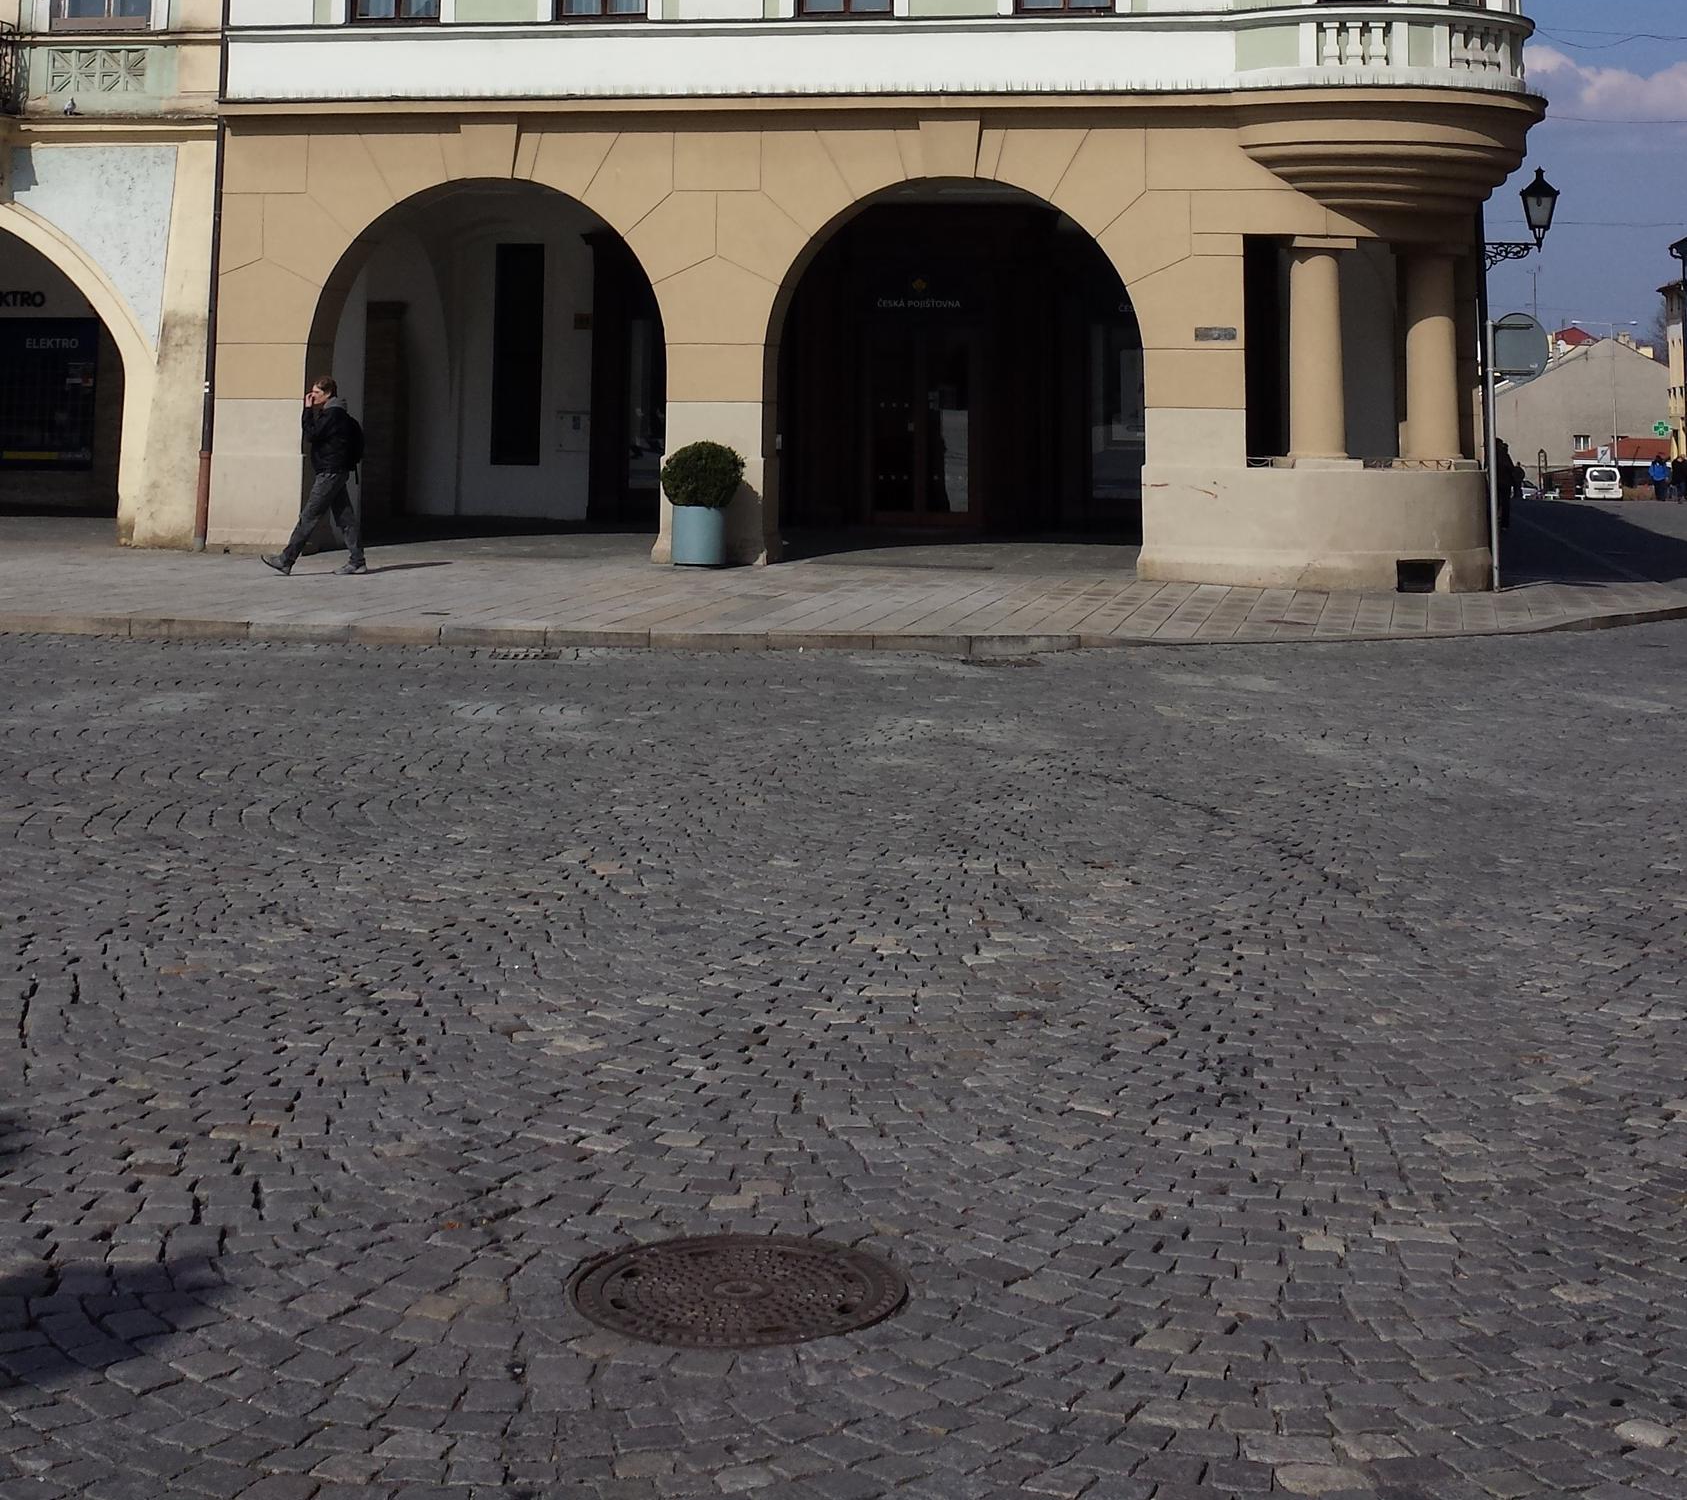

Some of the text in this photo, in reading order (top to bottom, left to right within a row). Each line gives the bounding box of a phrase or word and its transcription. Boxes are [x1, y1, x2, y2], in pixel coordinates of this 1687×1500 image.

[877, 298, 961, 308] ČESKÁ POJIŠŤOVNA
[25, 337, 80, 349] ELEKTRO
